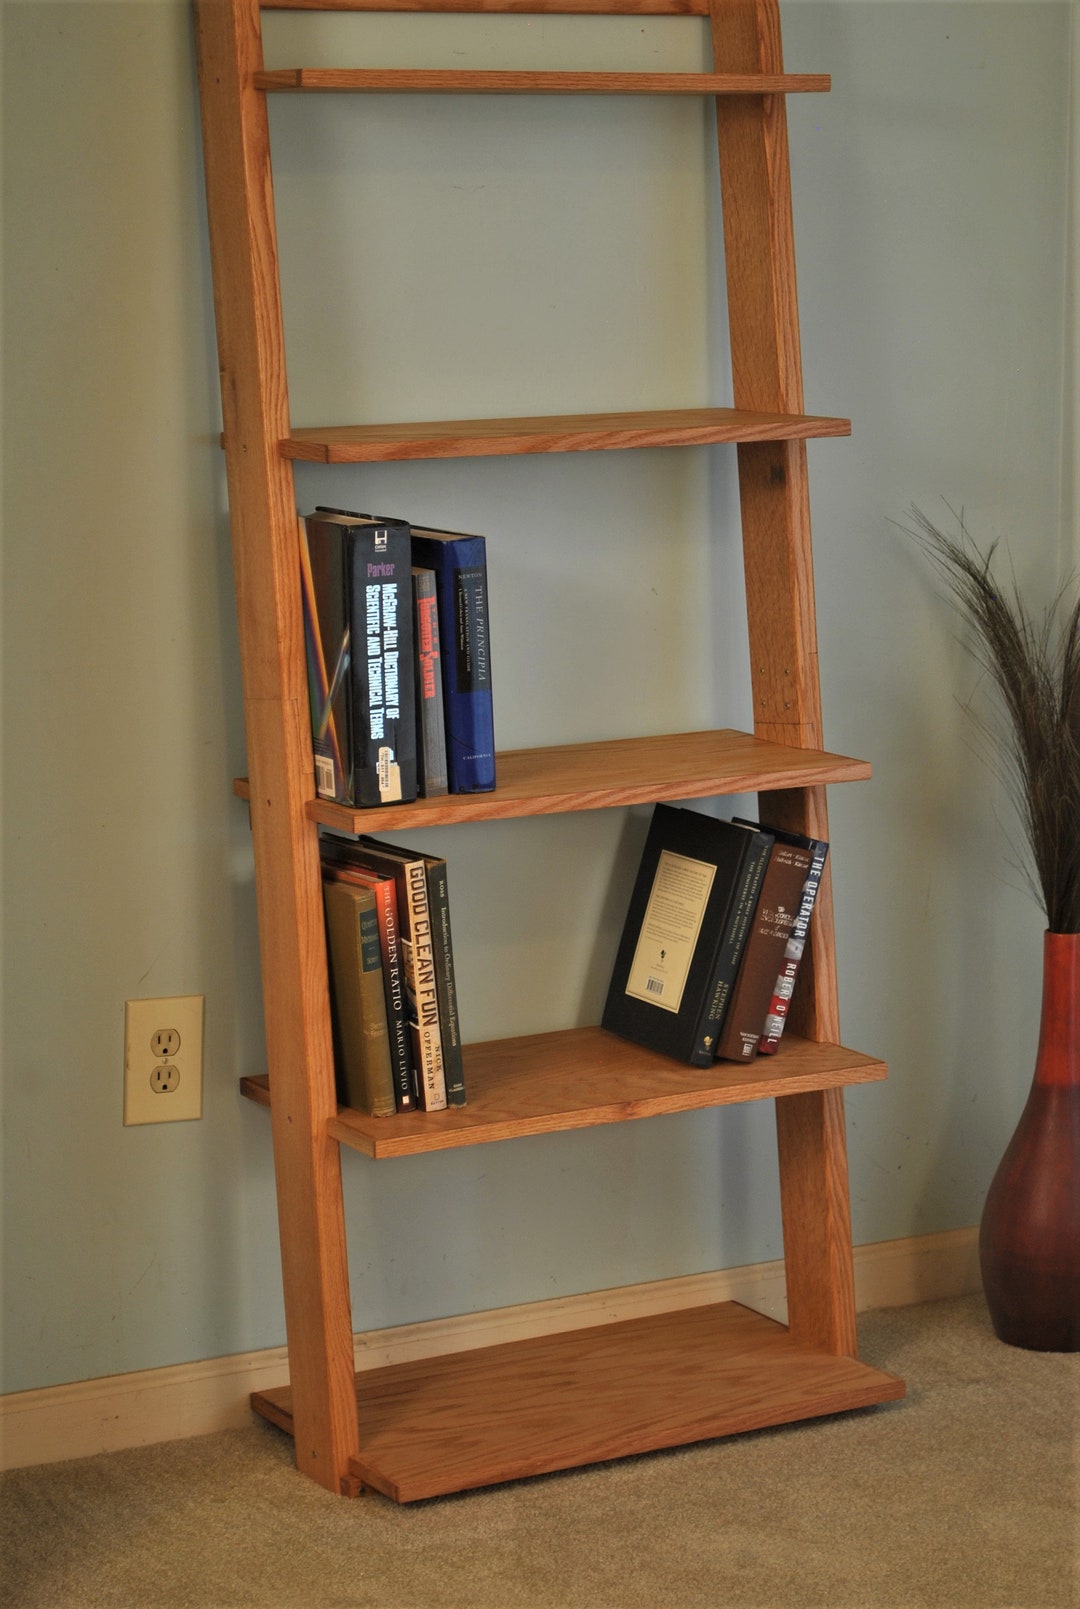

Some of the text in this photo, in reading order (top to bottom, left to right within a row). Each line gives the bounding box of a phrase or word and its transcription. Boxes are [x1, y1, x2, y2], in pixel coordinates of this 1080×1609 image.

[367, 562, 395, 577] Parker
[366, 584, 385, 740] SCIENTIFIC AND TECHNICAL TERMS
[475, 586, 487, 681] THE PRINCIPIA
[384, 651, 399, 706] DICTIONARY
[419, 651, 438, 698] SOLDIER
[386, 708, 400, 719] OF
[794, 856, 824, 938] THE OPERATOR
[409, 866, 437, 1027] GOOD CLEAN FUN
[383, 885, 408, 1090] THE GOLDEN RATIO MARIO LIVIO
[708, 980, 724, 1020] HAWKING
[715, 983, 729, 1020] STEPHEN
[767, 962, 797, 1043] ROBERT O'NEILL
[423, 1031, 435, 1090] OFFERMAN
[435, 1046, 443, 1072] NICK
